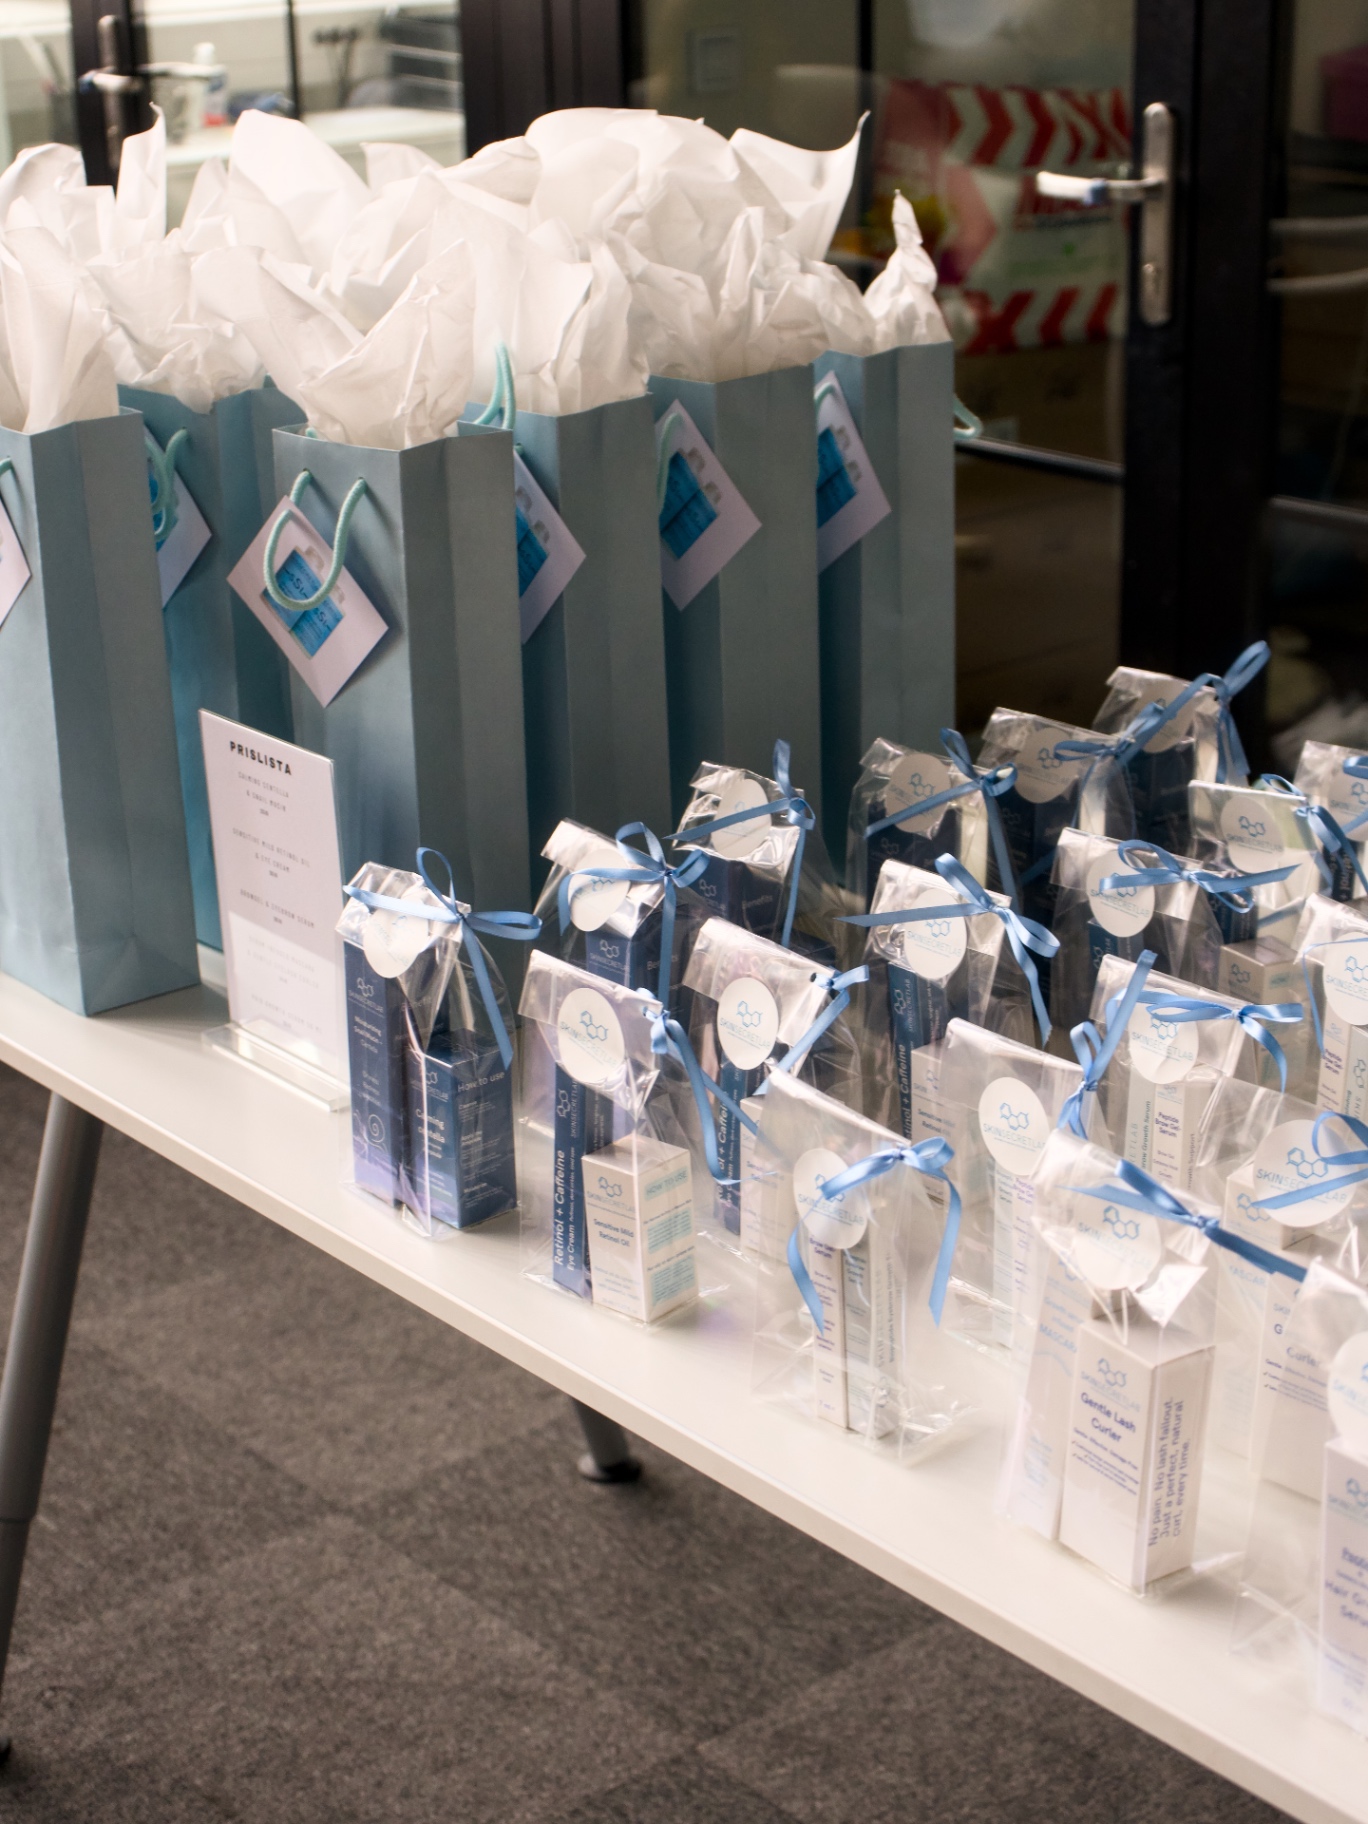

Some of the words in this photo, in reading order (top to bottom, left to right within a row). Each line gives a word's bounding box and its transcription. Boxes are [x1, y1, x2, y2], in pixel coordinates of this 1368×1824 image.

[229, 741, 292, 775] PRISLISTA
[1131, 1031, 1194, 1062] SKINSECRETLAB
[458, 1080, 477, 1093] How
[478, 1076, 488, 1086] to
[490, 1071, 505, 1082] use
[898, 1043, 910, 1094] Caffeine
[1155, 1117, 1170, 1129] Brow
[1157, 1111, 1179, 1124] Peptide
[1159, 1127, 1178, 1138] Serum
[555, 1150, 566, 1205] Caffeine
[557, 1207, 564, 1216] +
[554, 1219, 565, 1266] Retinol
[567, 1224, 575, 1254] Cream
[567, 1254, 575, 1271] Eye
[1081, 1392, 1112, 1419] Gentle
[1114, 1412, 1137, 1433] Lash
[1170, 1400, 1184, 1446] natural
[1091, 1417, 1122, 1442] Curler
[1156, 1443, 1168, 1470] lash
[1154, 1471, 1165, 1491] No
[1176, 1473, 1189, 1506] every
[1165, 1500, 1173, 1508] a
[1148, 1528, 1159, 1546] No
[1160, 1511, 1172, 1538] Just
